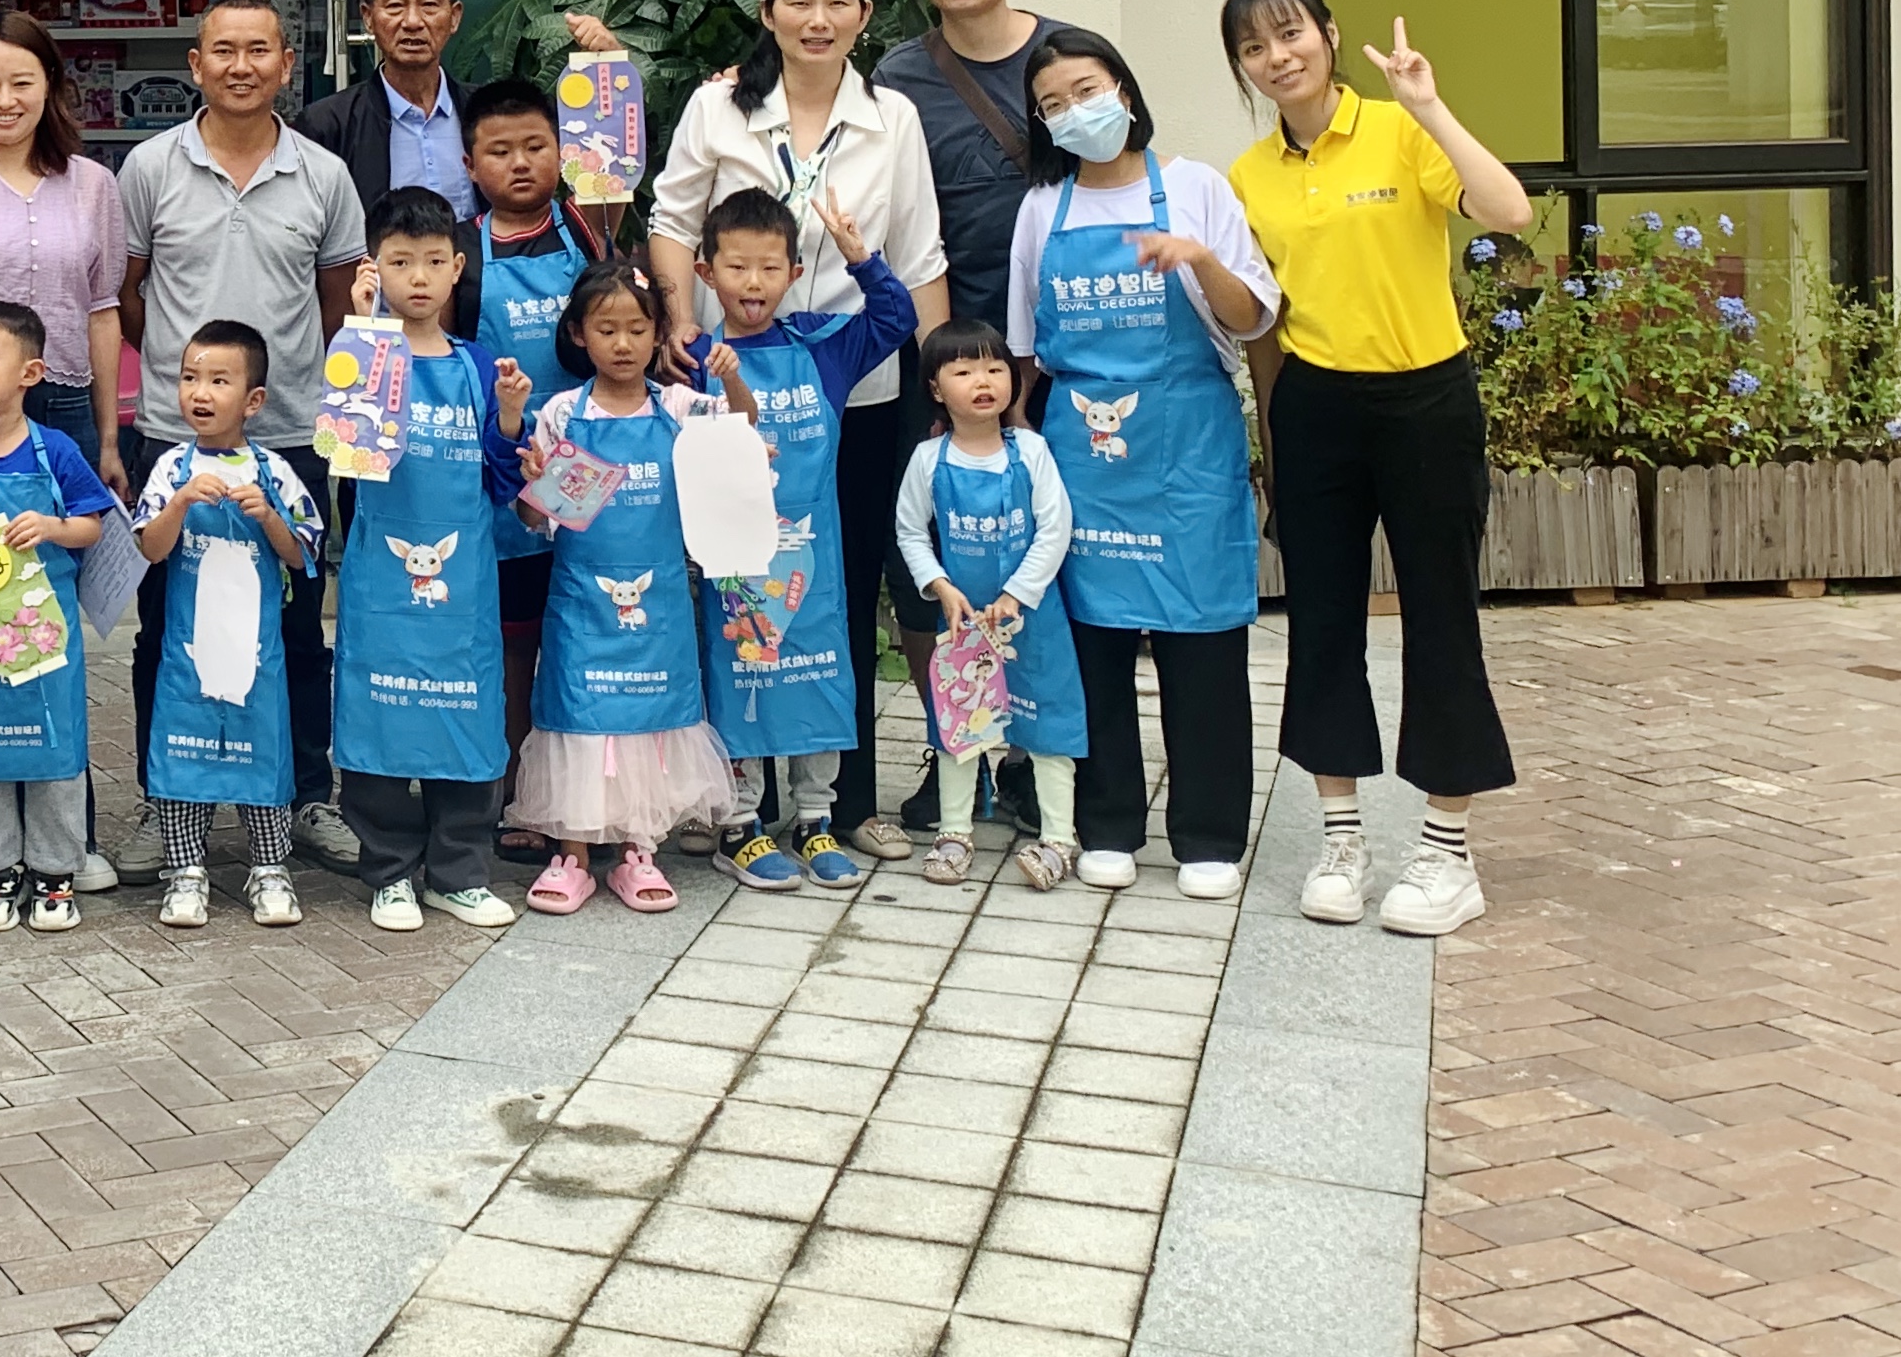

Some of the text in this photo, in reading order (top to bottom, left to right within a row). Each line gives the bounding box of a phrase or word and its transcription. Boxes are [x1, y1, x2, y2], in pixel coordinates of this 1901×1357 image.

[1049, 270, 1166, 300] 皇家迪智尼
[1057, 295, 1166, 313] ROYAL DEEDSNY
